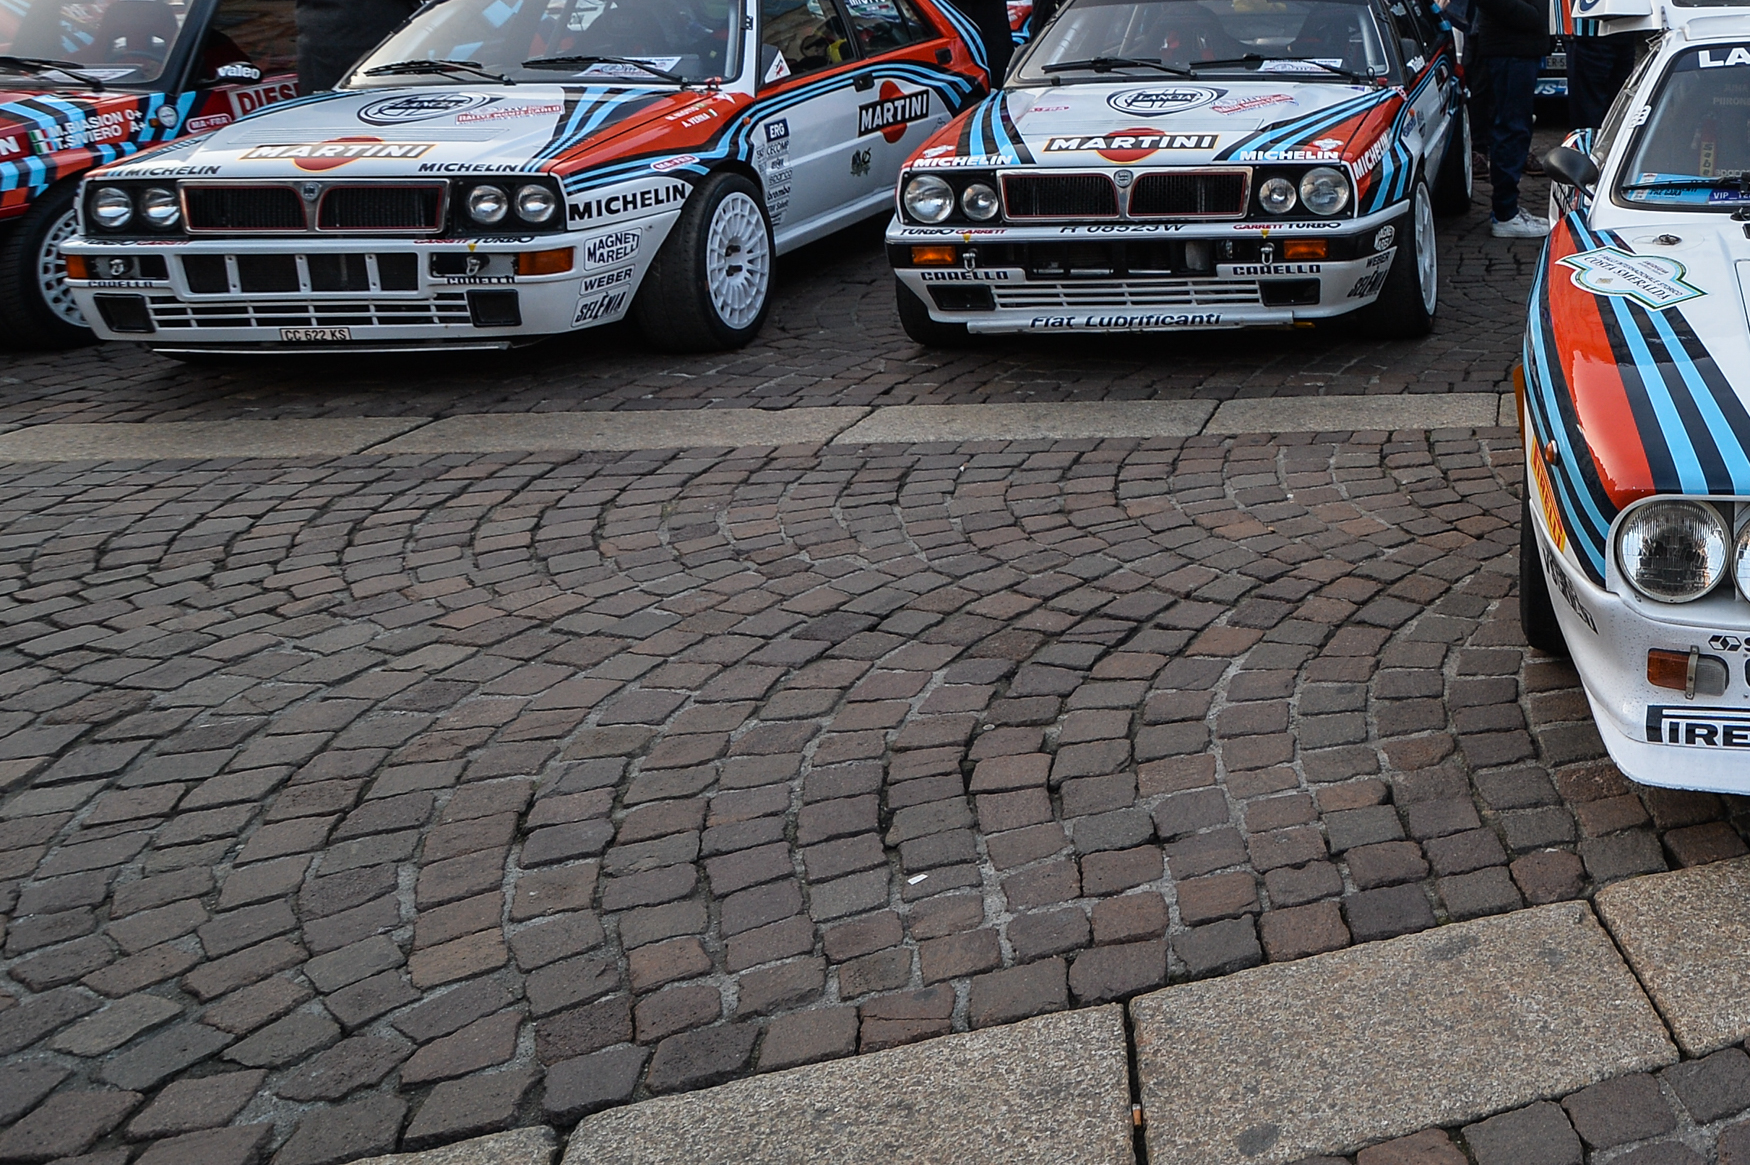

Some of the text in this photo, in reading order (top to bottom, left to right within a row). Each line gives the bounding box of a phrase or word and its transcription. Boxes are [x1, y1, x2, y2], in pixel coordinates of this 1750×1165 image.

[218, 63, 260, 80] valeo
[1135, 94, 1196, 102] LANCIA
[861, 93, 928, 133] MARTINI
[130, 121, 146, 134] A+
[770, 123, 785, 139] ERG
[1050, 136, 1215, 151] MARTINI
[249, 144, 428, 159] MARTINI
[1239, 150, 1339, 160] MICHELIN
[1353, 133, 1391, 180] MICHELIN
[418, 163, 519, 173] MICHELIN
[914, 155, 1011, 167] MICHELIN
[125, 165, 221, 177] MICHELIN
[568, 183, 686, 222] MICHELIN
[1367, 254, 1390, 268] WEBER
[921, 271, 1008, 281] CARELLO
[1233, 265, 1321, 276] CARELLO
[584, 268, 632, 291] WEBER
[1584, 256, 1670, 300] COSTA SMERALDA
[1030, 313, 1222, 328] Fiat Lubrificanti
[285, 329, 347, 340] CC 622 KS
